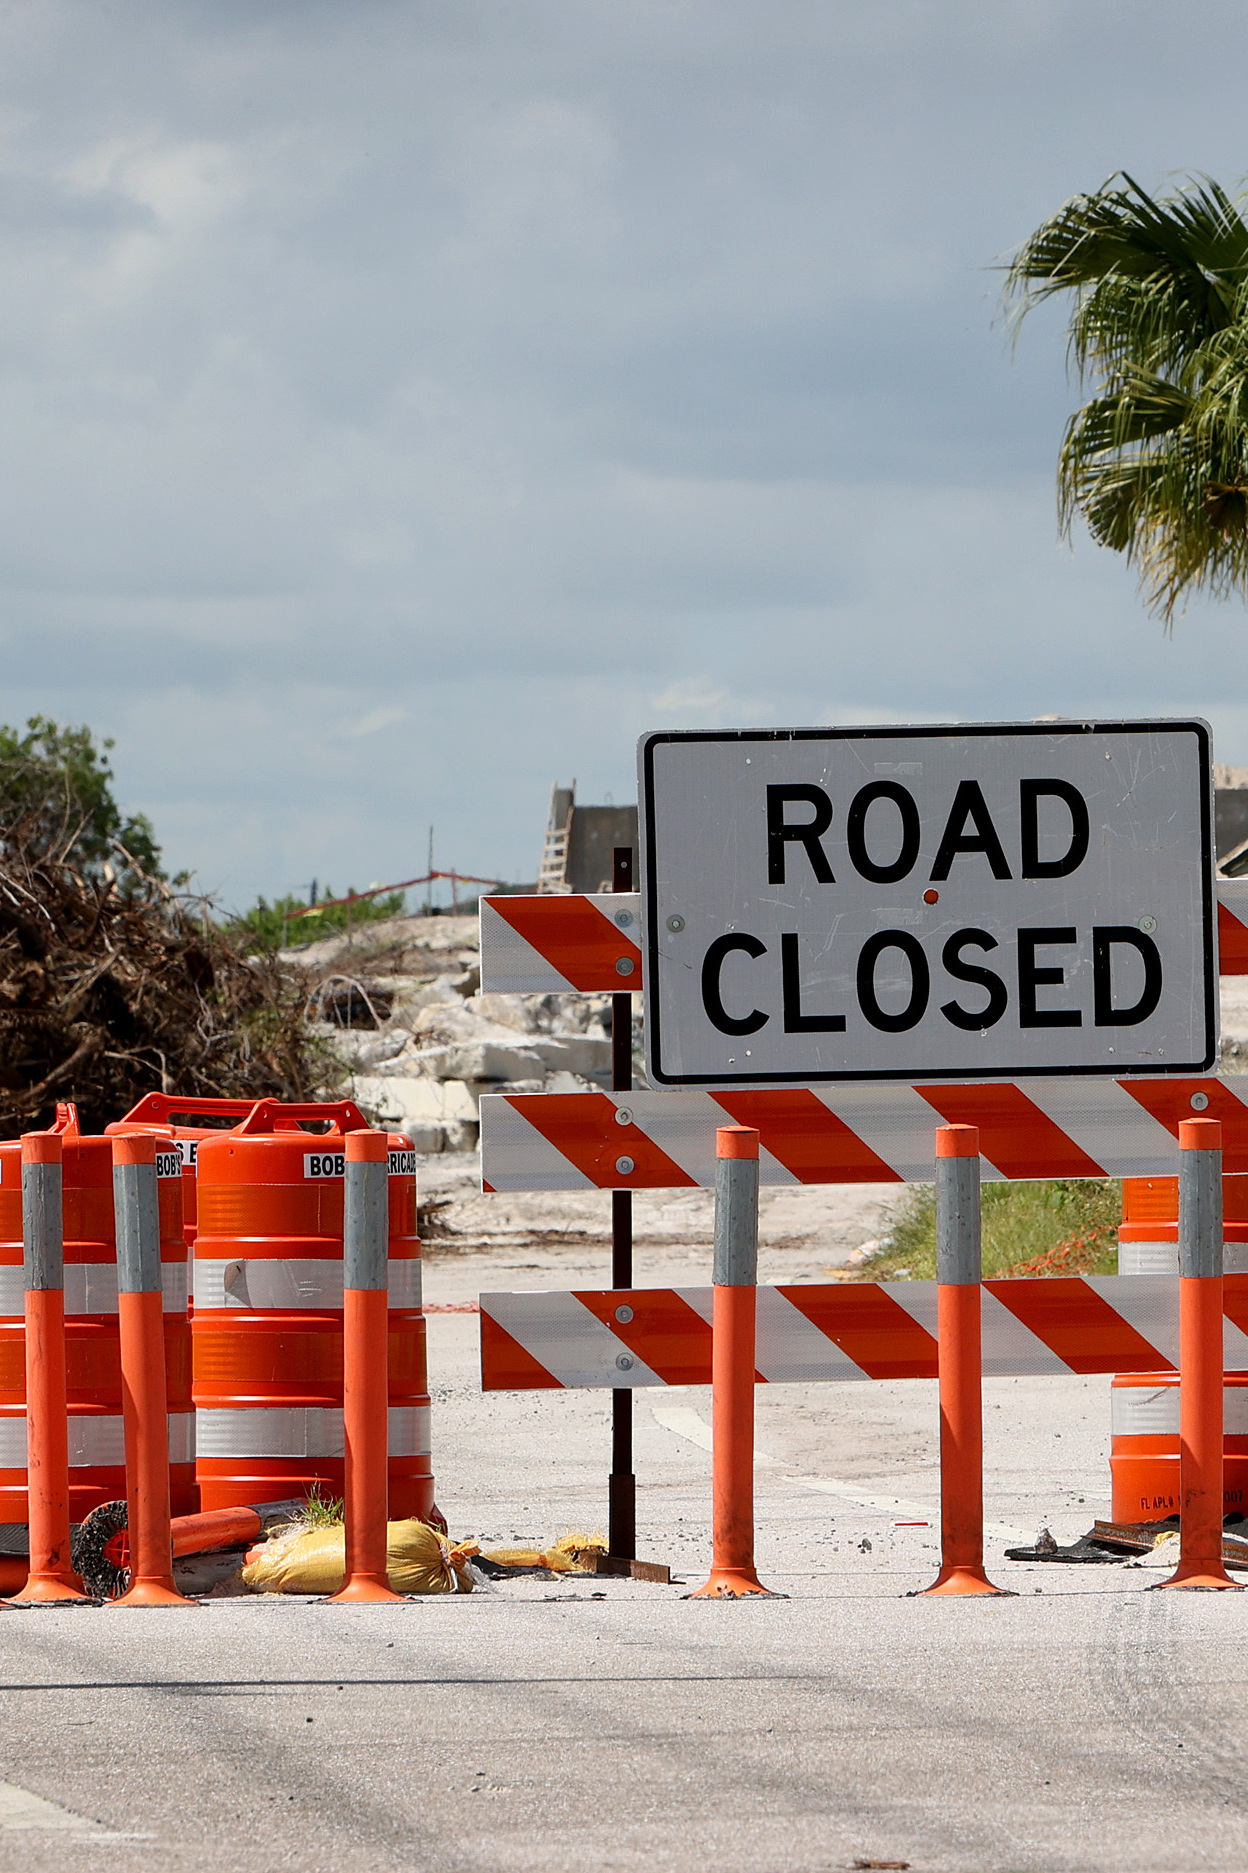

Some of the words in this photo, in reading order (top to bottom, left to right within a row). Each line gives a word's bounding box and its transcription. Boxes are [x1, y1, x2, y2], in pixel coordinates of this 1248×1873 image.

[767, 779, 1089, 884] ROAD
[702, 926, 1162, 1036] CLOSED
[310, 1155, 344, 1176] BOB
[1141, 1497, 1150, 1510] FL
